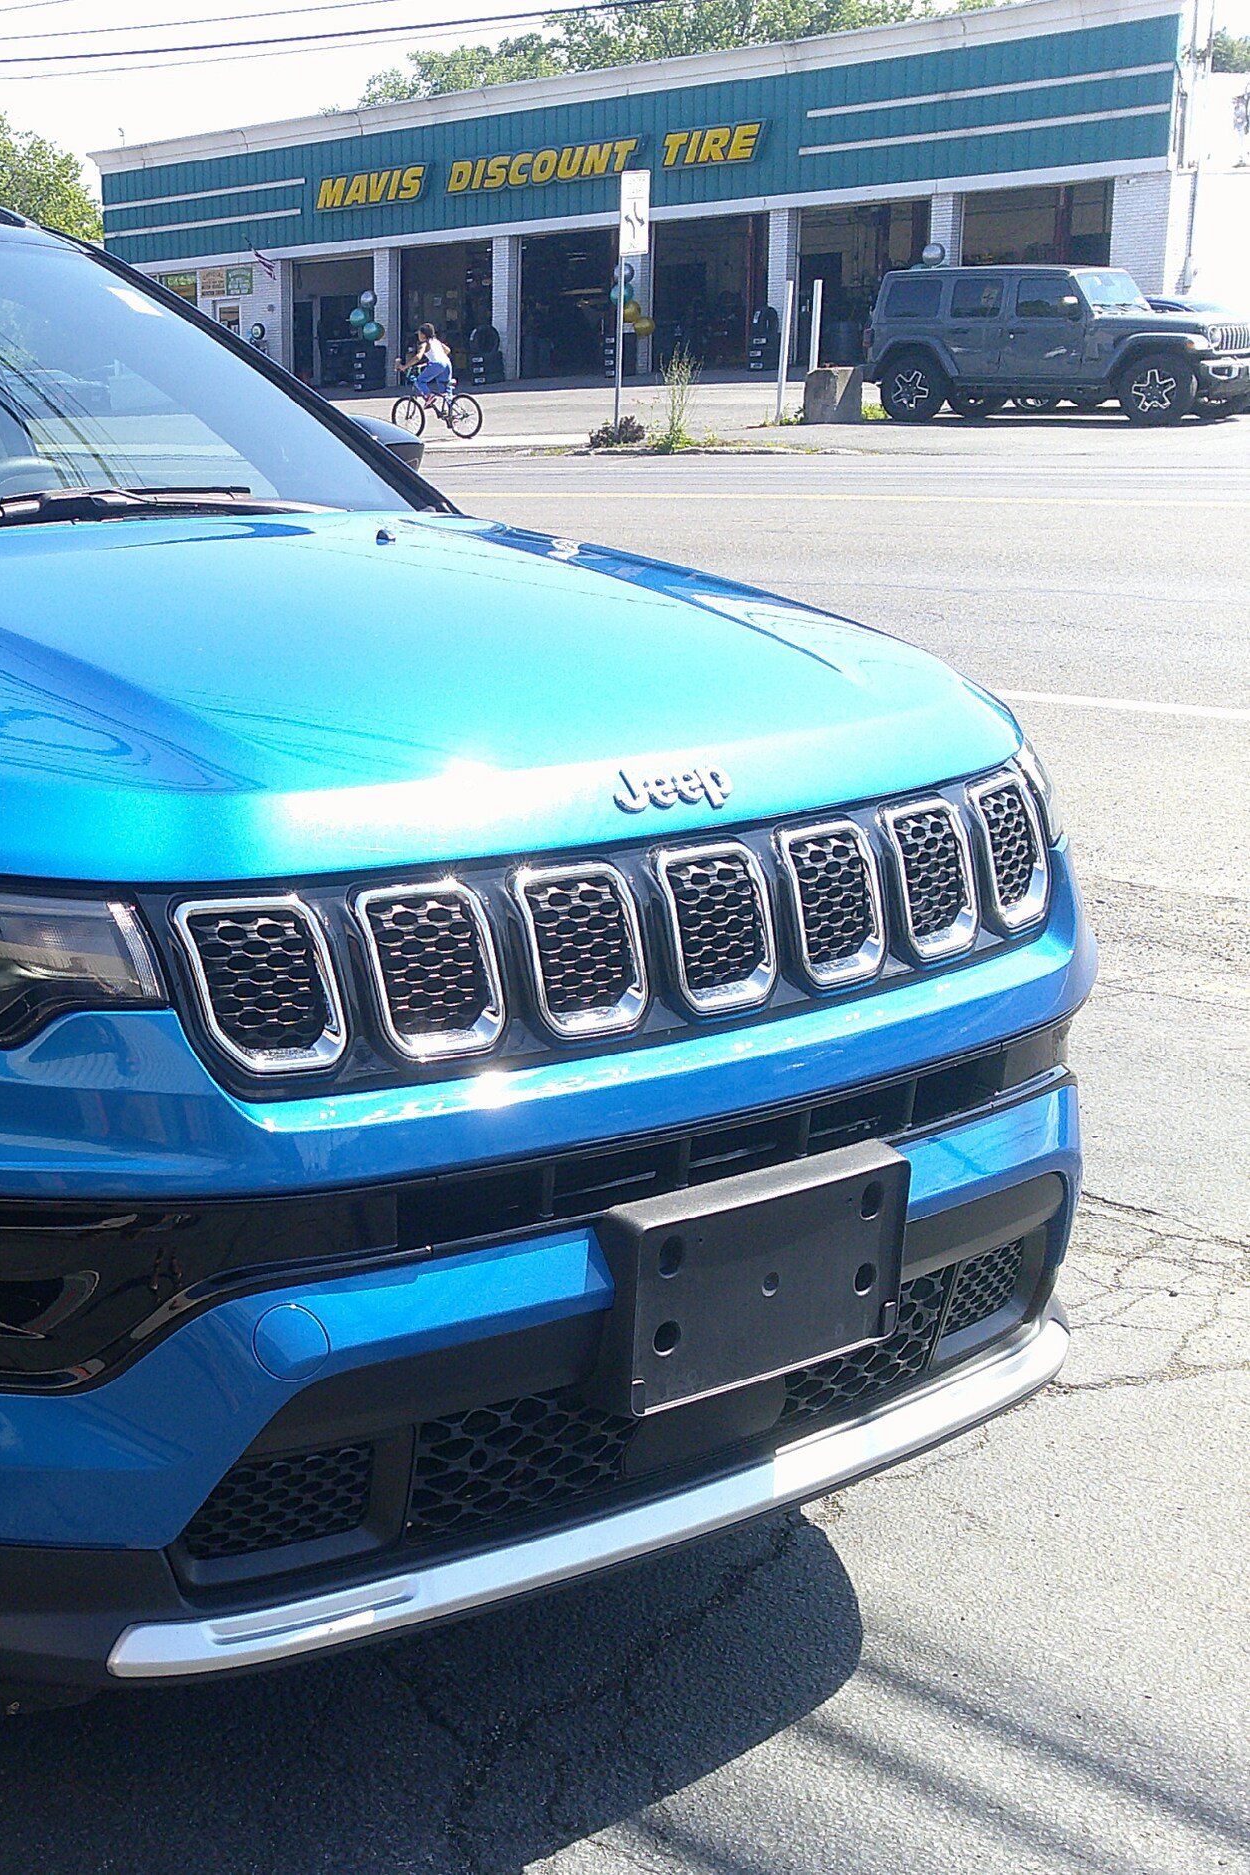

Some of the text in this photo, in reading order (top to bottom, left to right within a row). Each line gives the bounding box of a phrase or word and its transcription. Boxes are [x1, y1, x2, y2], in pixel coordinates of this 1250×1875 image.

[316, 166, 425, 210] MAVIS
[447, 139, 638, 192] DISCOUNT
[663, 124, 760, 166] TIRE
[613, 764, 734, 814] Jeep
